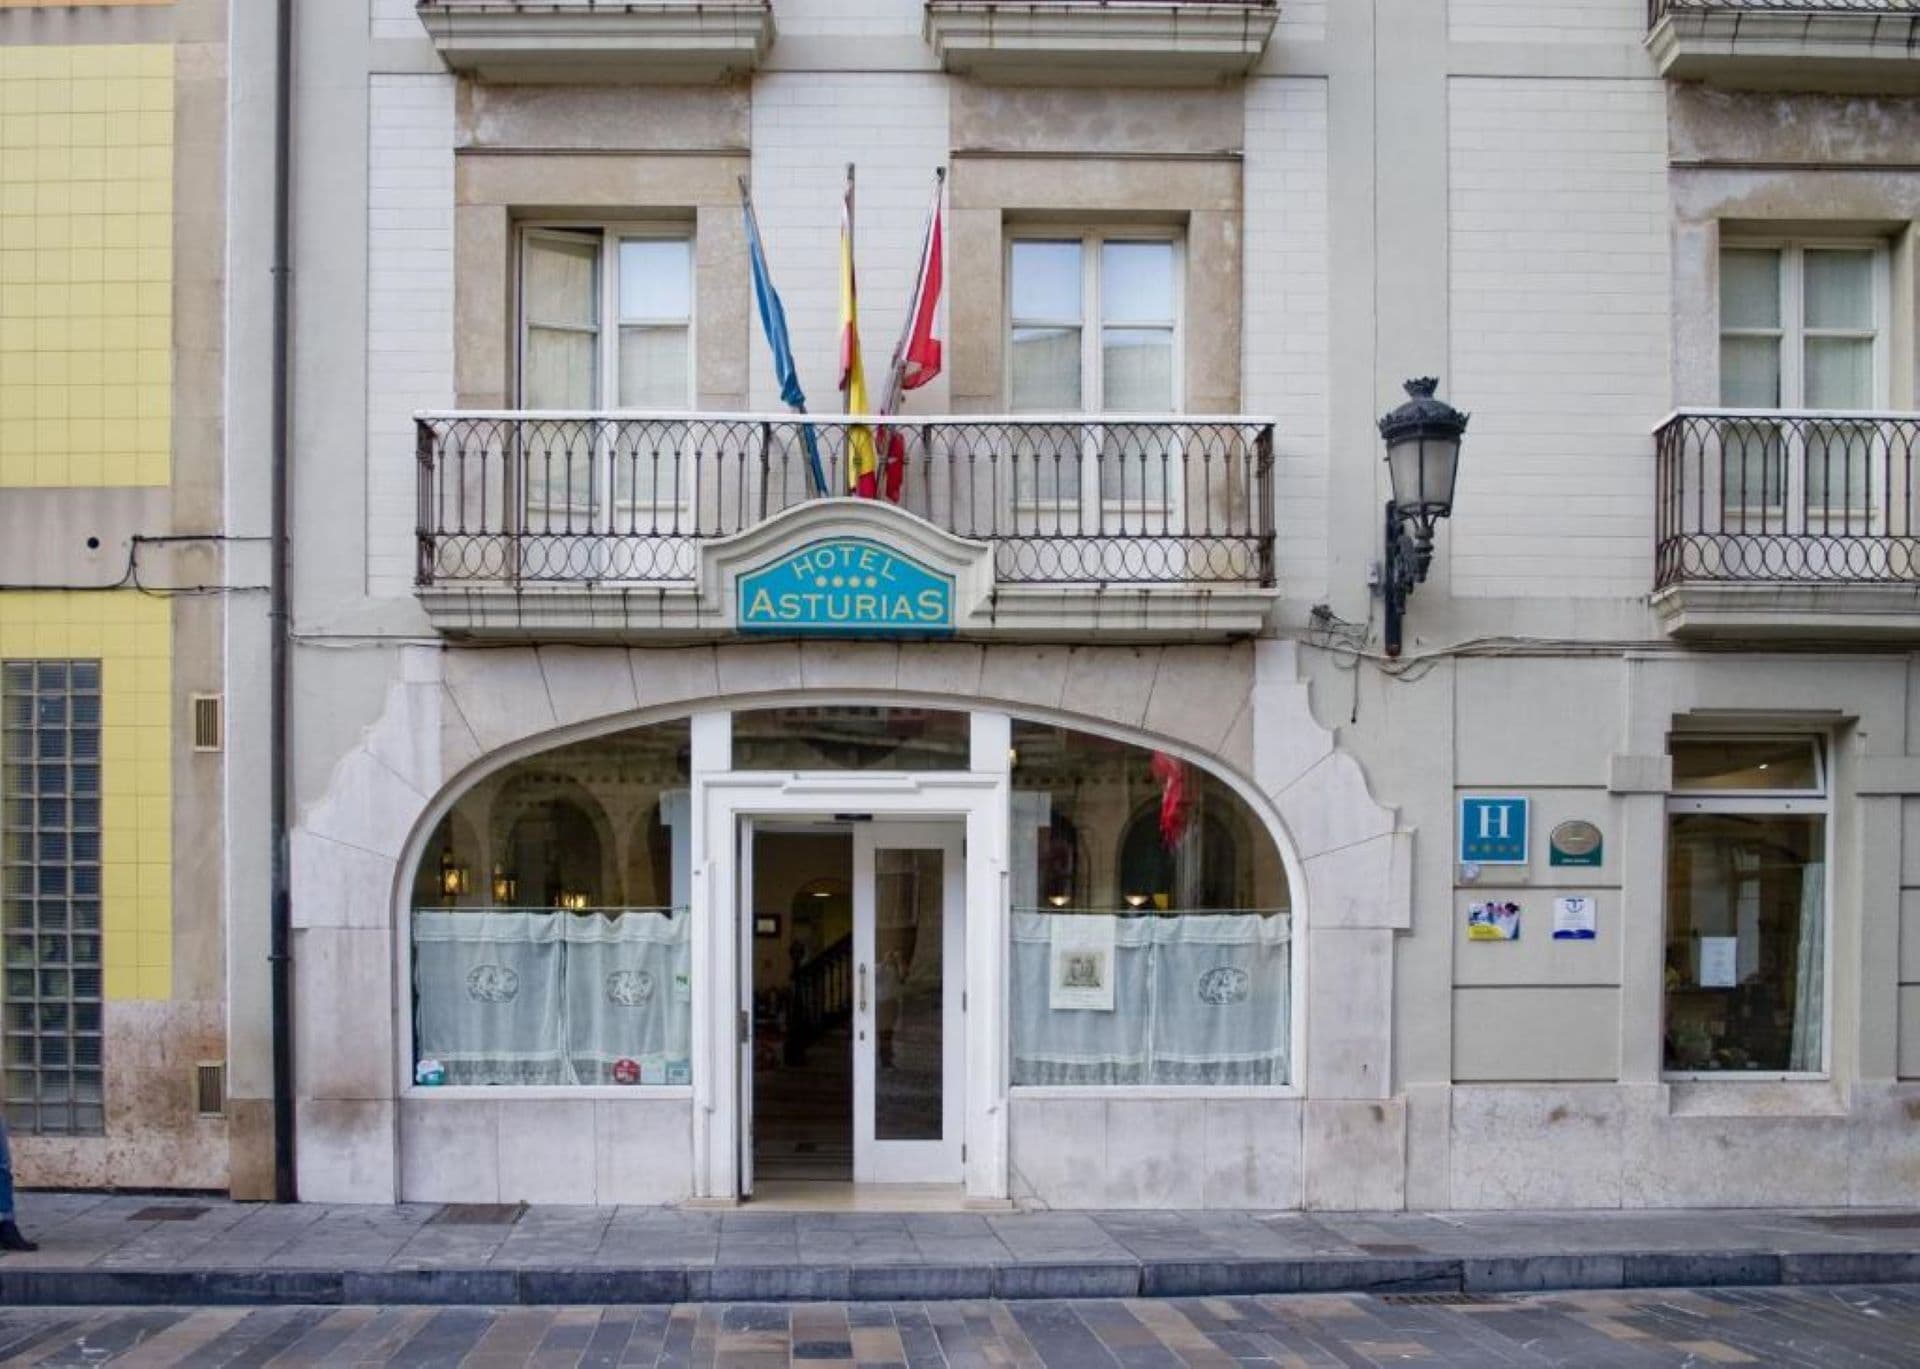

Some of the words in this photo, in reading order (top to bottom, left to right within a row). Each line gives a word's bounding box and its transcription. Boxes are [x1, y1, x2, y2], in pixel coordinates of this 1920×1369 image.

[792, 546, 897, 582] HOTEL
[747, 588, 945, 621] ASTURIAS
[1477, 804, 1513, 839] H
